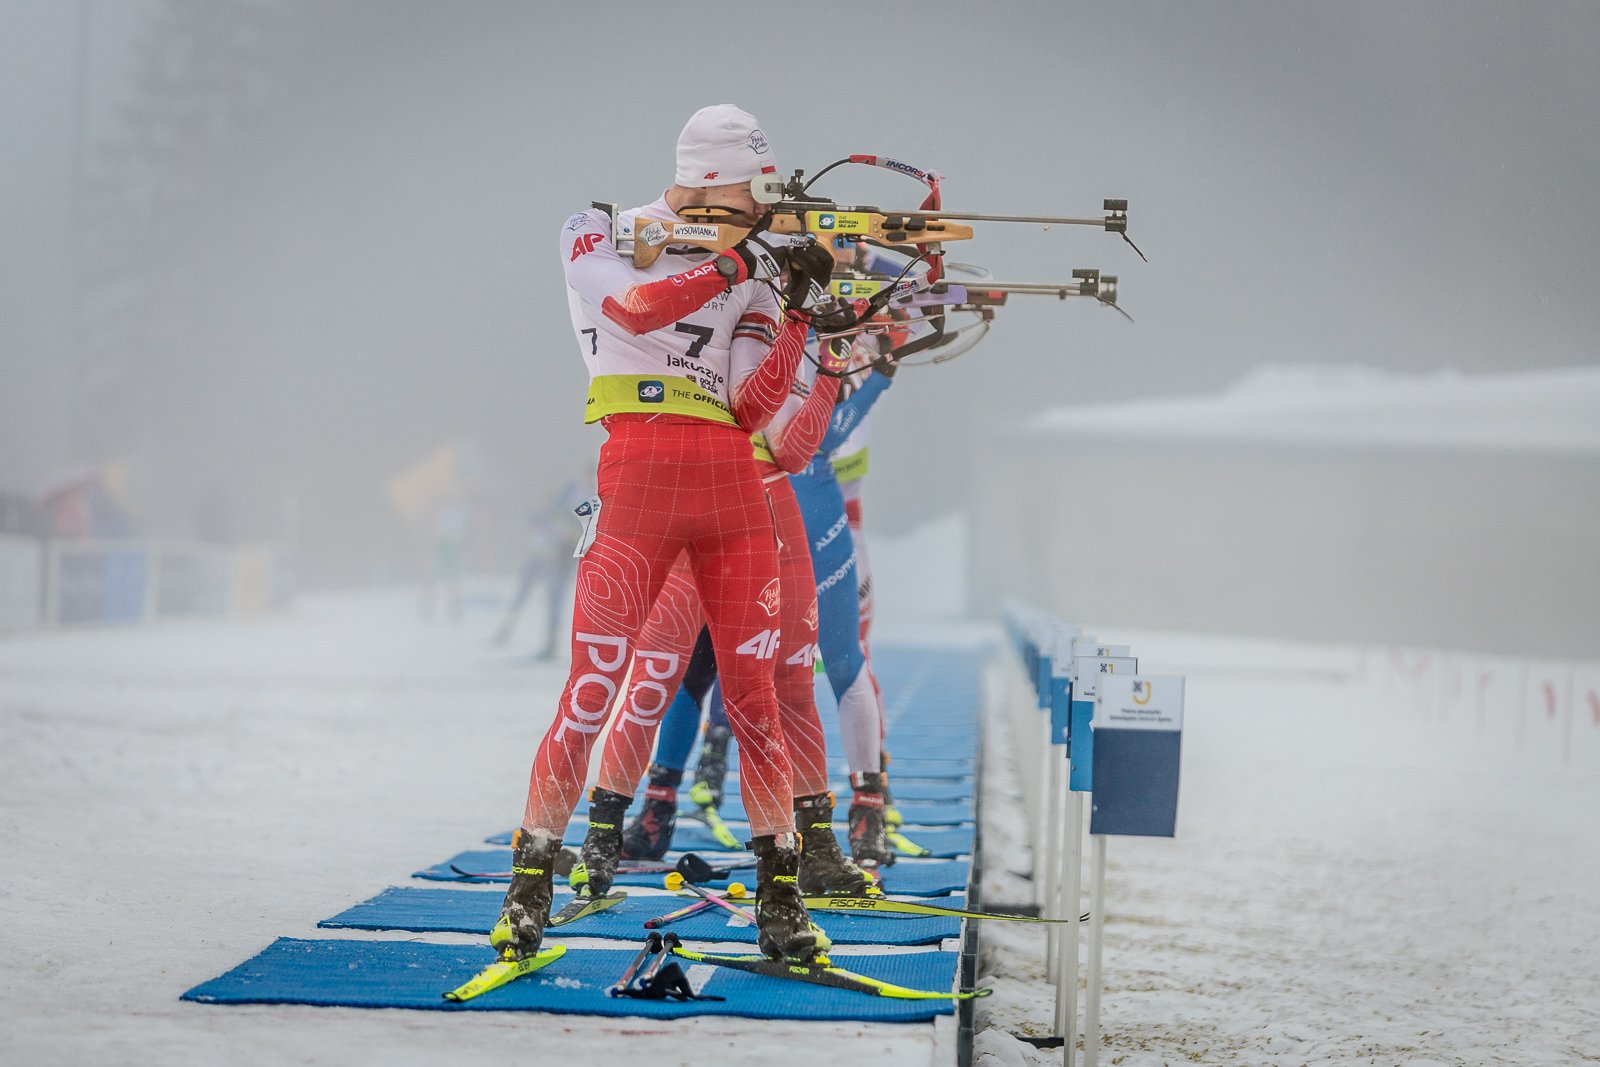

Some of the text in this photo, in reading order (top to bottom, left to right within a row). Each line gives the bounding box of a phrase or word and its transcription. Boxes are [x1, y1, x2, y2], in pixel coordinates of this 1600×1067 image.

[645, 227, 662, 237] Polski
[674, 226, 718, 238] WYSOWIANKA
[684, 264, 718, 280] LAPU
[703, 301, 725, 311] ORT
[582, 328, 598, 356] 7
[674, 322, 715, 359] 7
[672, 389, 731, 414] THE OFFICIA
[554, 632, 628, 743] POL
[616, 650, 680, 732] POL
[828, 898, 877, 909] FISCHER
[788, 965, 810, 975] FISCHER
